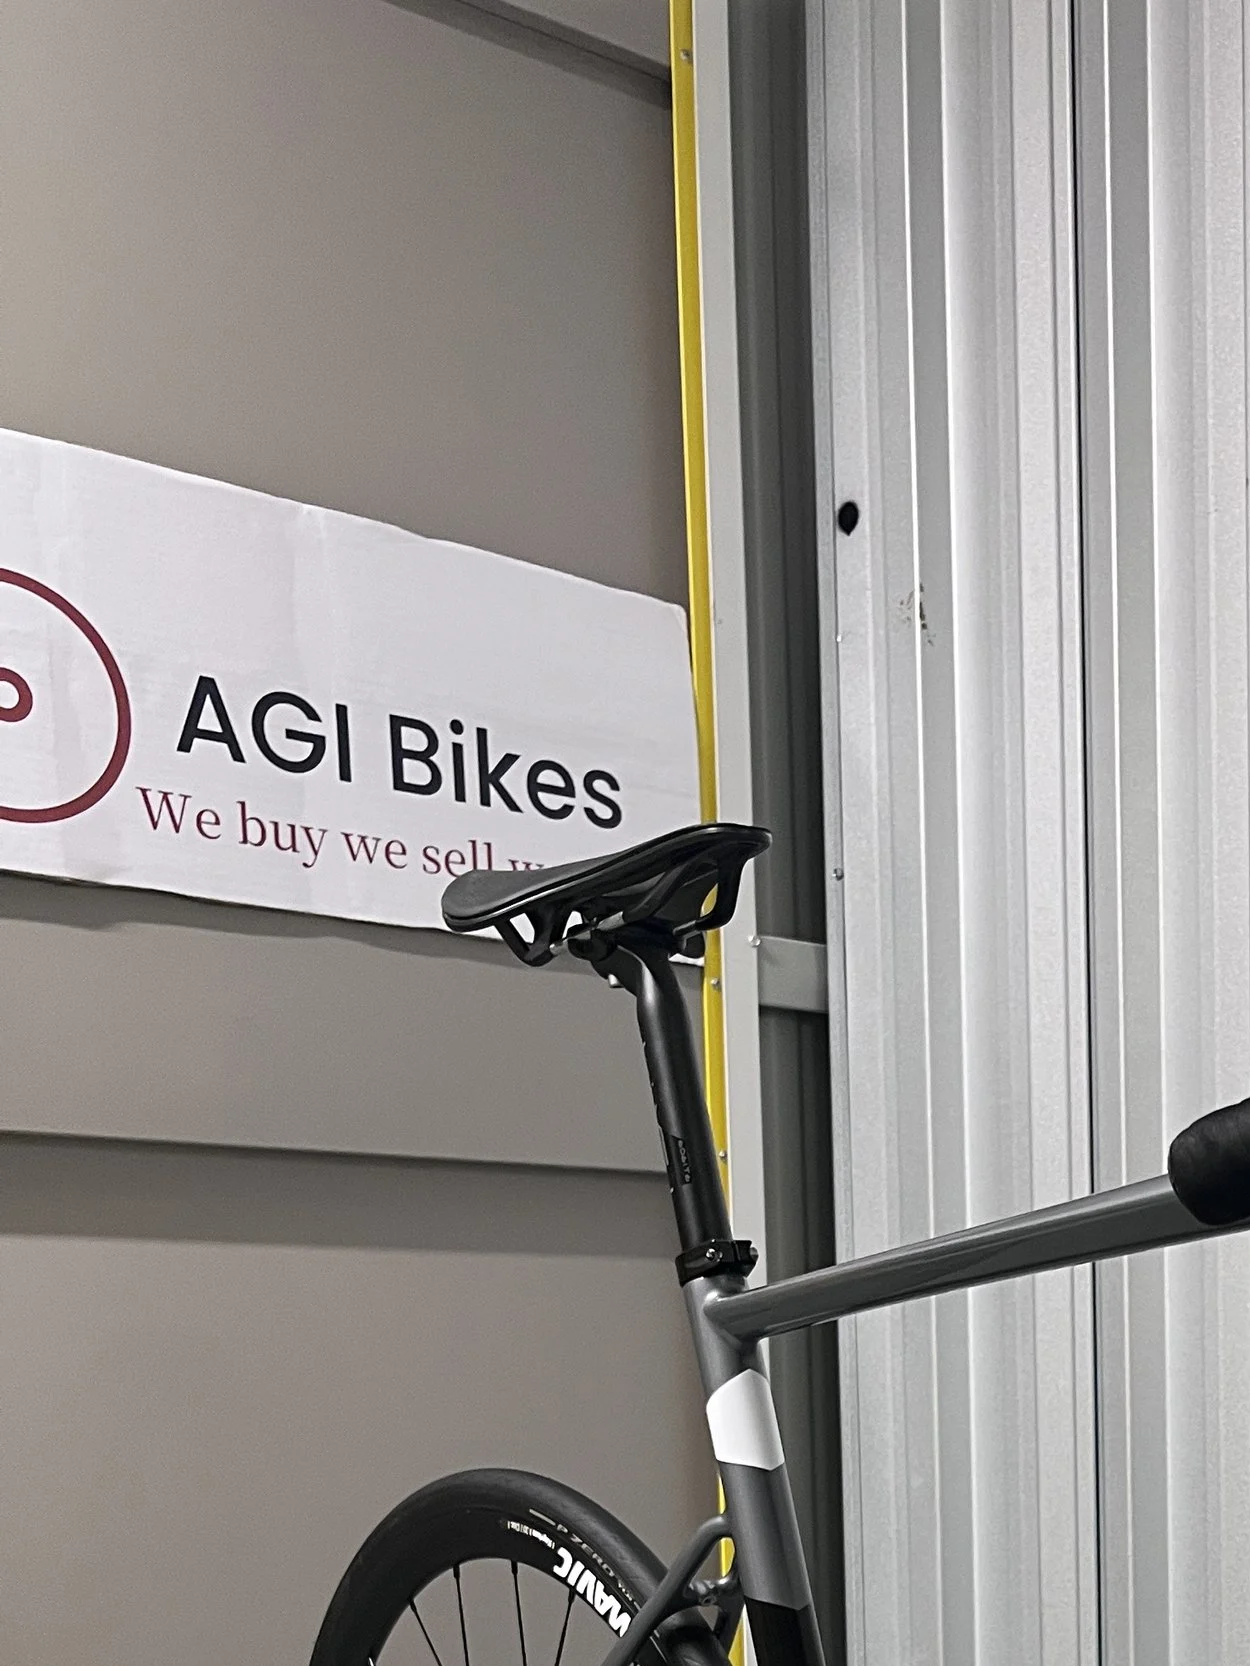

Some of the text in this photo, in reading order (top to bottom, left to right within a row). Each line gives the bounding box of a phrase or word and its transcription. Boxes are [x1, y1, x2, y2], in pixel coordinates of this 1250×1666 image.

[177, 675, 623, 829] AGI Bikes
[135, 786, 494, 878] We buy we sell
[553, 1546, 632, 1638] MAVIC
